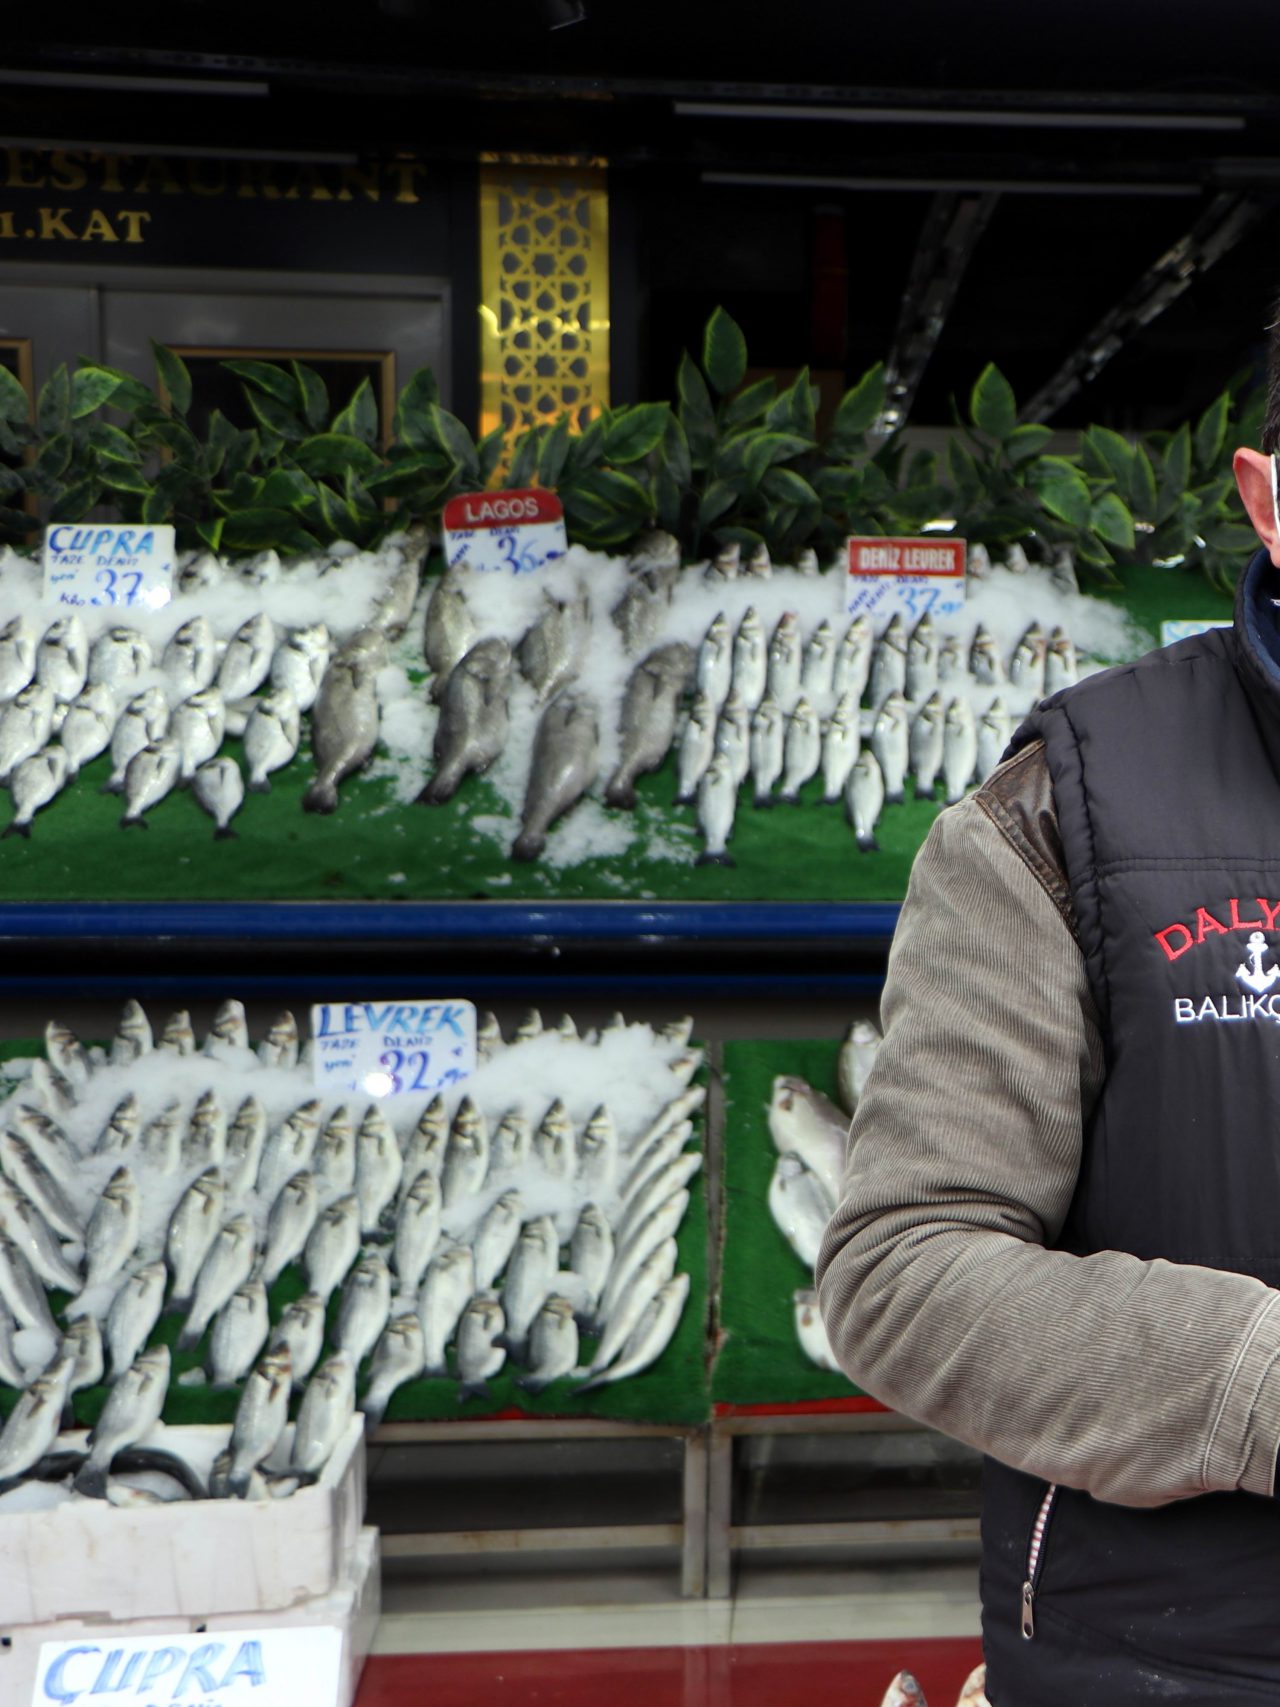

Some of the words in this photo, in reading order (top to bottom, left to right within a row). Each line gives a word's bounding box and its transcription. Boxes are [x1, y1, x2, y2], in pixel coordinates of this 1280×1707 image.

[0, 148, 428, 204] ESTAURANT
[465, 497, 539, 522] LAGOS
[316, 1002, 466, 1038] LEVREK
